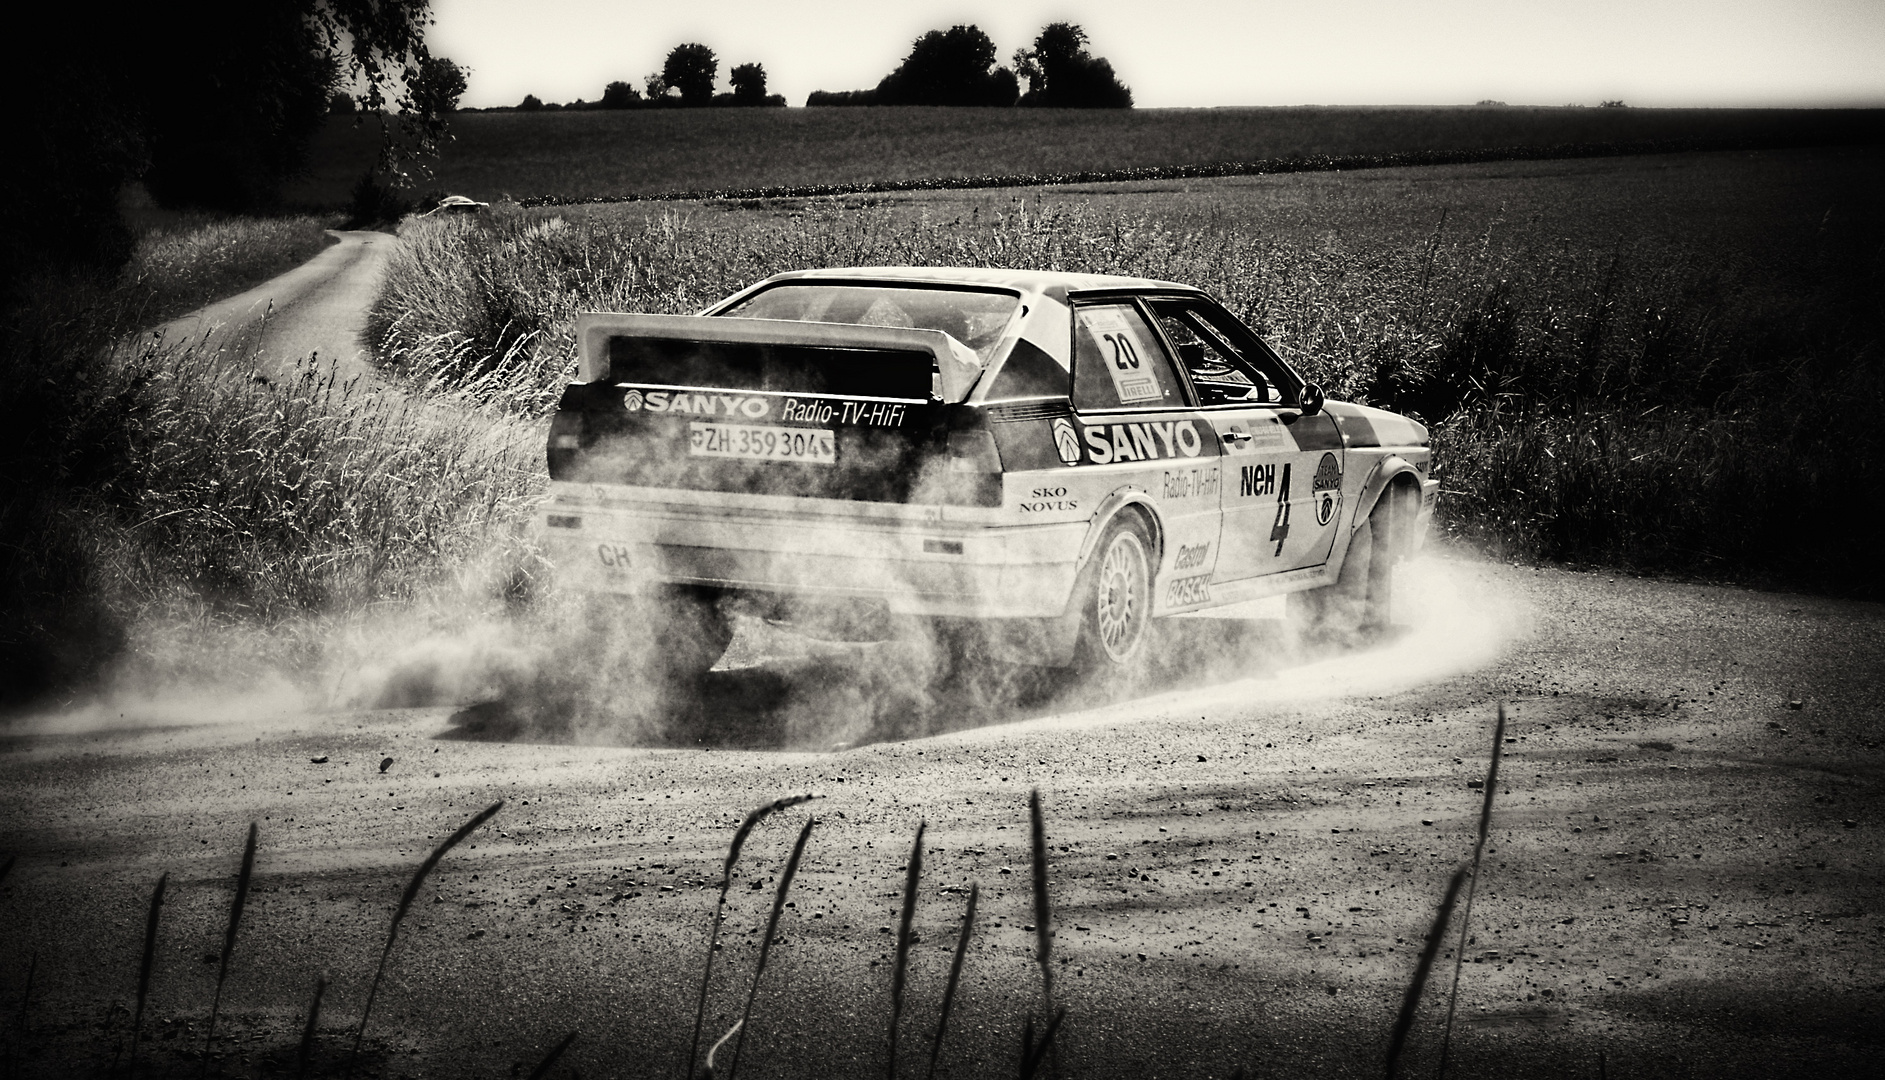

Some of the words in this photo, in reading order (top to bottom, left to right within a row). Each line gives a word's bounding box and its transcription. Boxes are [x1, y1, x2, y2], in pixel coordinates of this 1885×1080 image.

[1103, 332, 1140, 370] 20
[1120, 377, 1156, 398] PIRELLI
[645, 392, 769, 418] SANYO
[782, 398, 907, 427] Radio-TV-HiFi
[1084, 420, 1202, 464] SANYO
[1163, 466, 1219, 499] Radio-TV-HiFi
[1314, 478, 1340, 490] SANYO
[1320, 464, 1337, 477] TEAM
[1032, 487, 1067, 498] SKO
[1019, 501, 1078, 513] NOVUS
[1270, 463, 1291, 557] 4
[598, 543, 632, 568] CH
[1166, 575, 1211, 607] BOSCH
